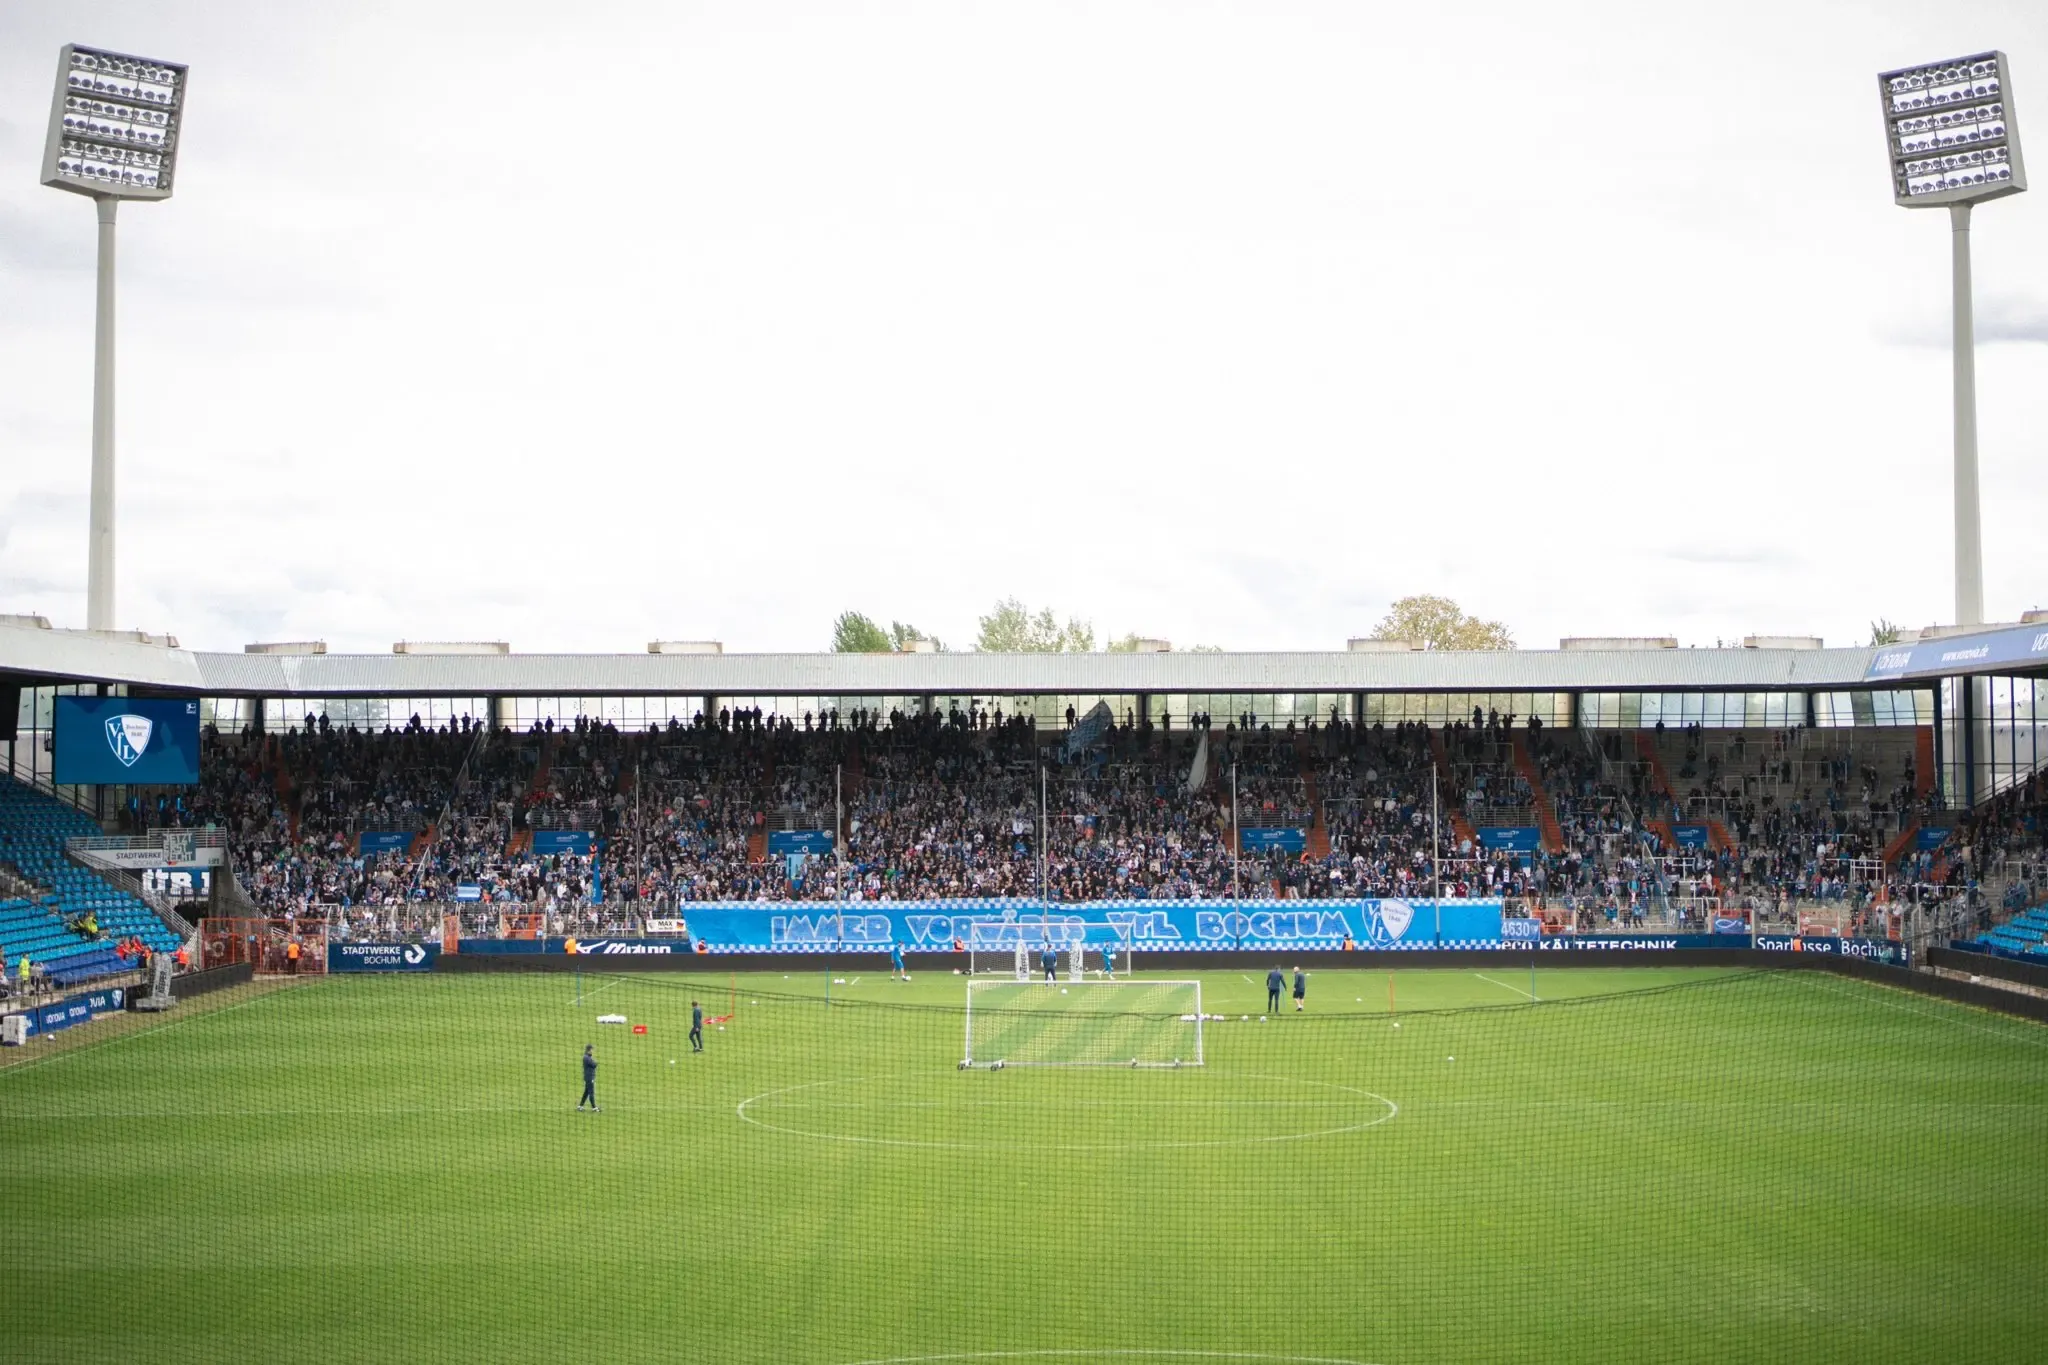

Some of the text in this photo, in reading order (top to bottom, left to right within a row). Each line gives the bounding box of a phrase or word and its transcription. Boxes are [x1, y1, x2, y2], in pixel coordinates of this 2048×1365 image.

[116, 851, 161, 860] STADTWERKE
[771, 914, 893, 944] IMMER
[1196, 910, 1353, 940] BOCHUM
[1501, 921, 1530, 937] 4630
[342, 946, 400, 955] STADTWERKE
[364, 956, 400, 964] BOCHUM
